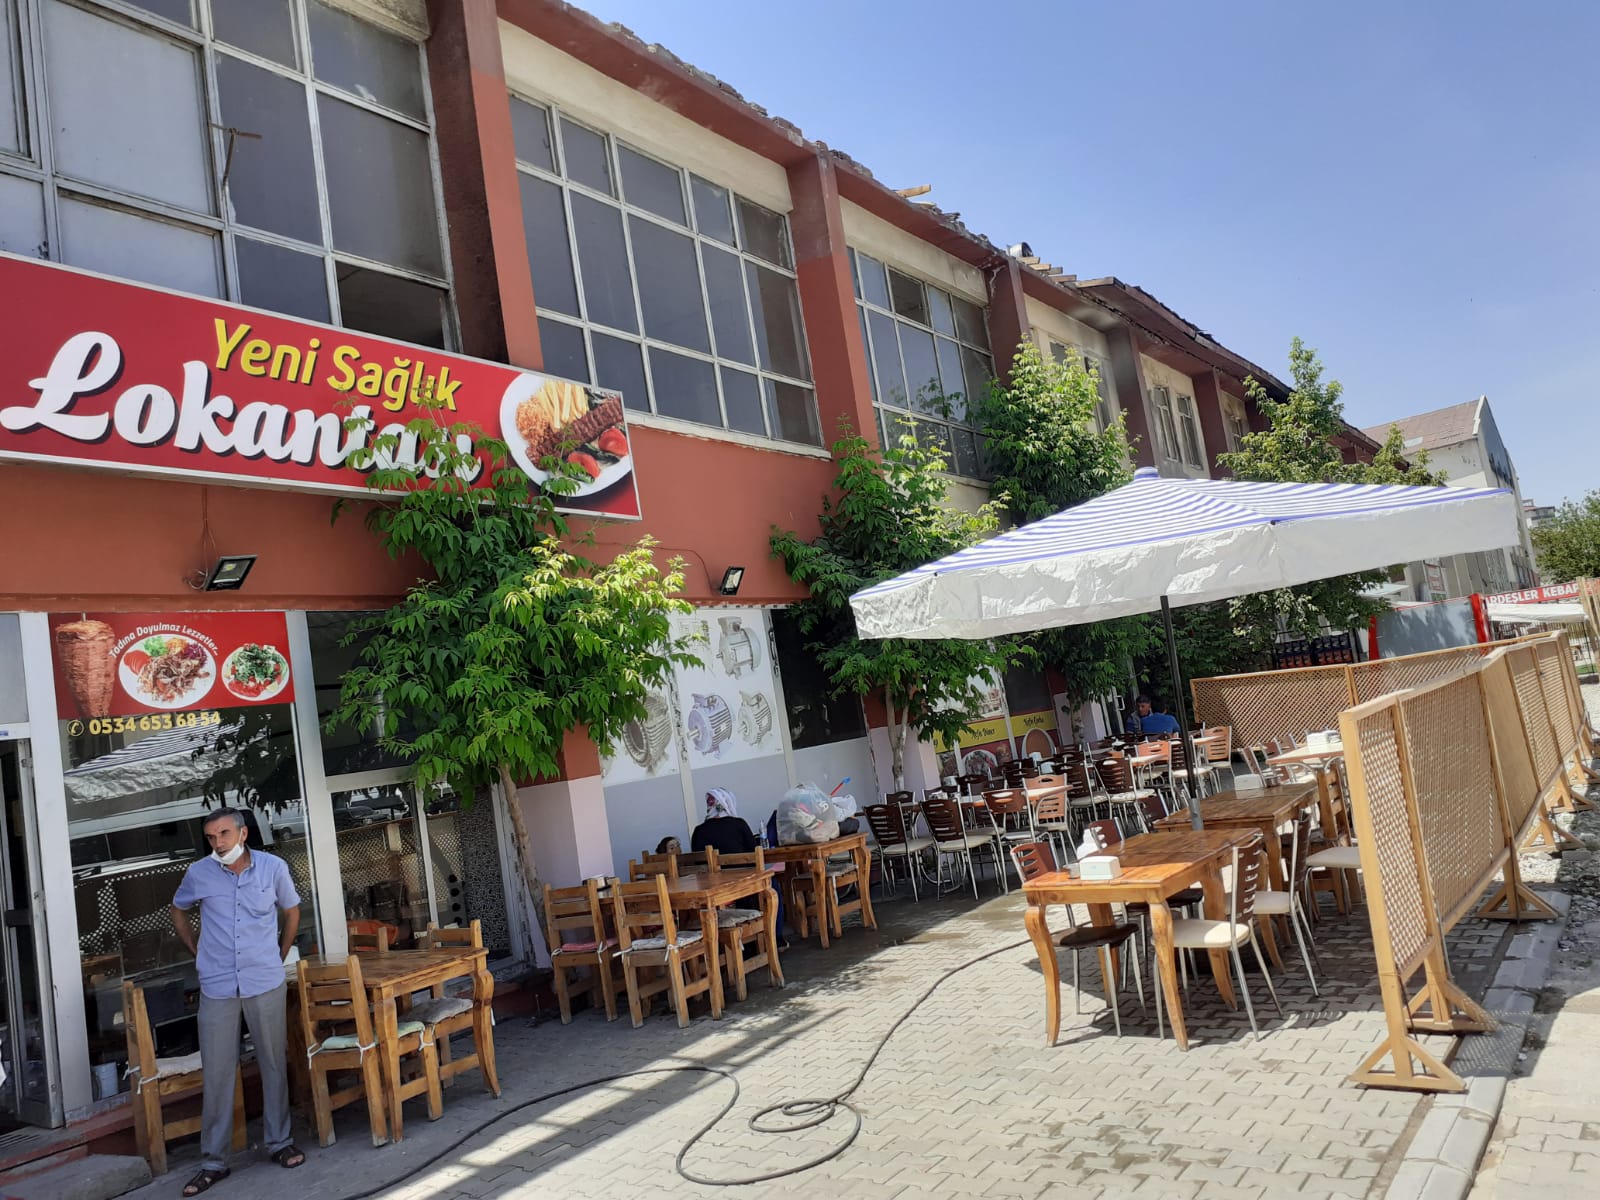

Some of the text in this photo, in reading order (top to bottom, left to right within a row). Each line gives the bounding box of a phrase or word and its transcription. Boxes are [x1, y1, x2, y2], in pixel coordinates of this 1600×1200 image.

[214, 318, 462, 411] Yeni Sağlık
[109, 631, 136, 658] Tadına
[136, 622, 181, 637] Doyulmaz
[89, 711, 221, 735] 0534 653 68 54
